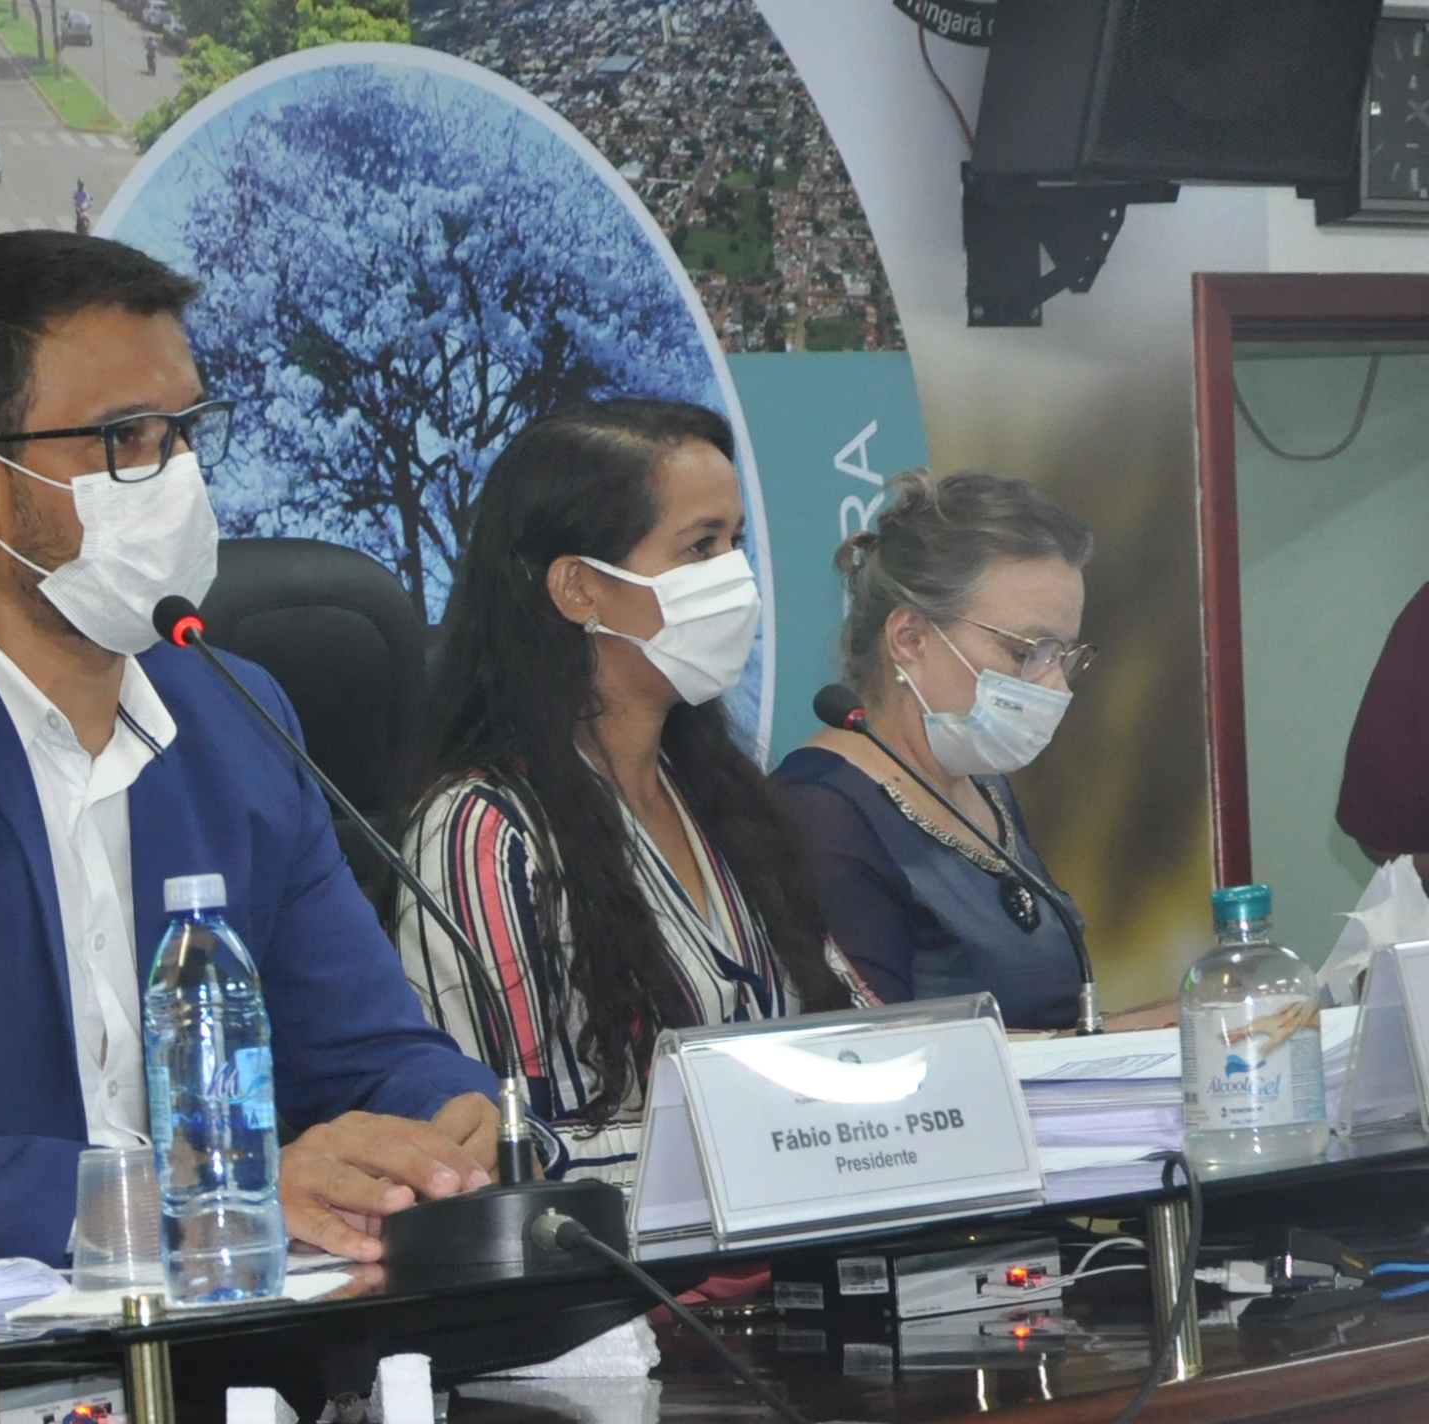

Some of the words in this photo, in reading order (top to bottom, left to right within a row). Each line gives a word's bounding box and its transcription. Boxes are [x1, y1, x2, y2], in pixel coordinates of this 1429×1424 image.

[771, 1127, 832, 1152] Fábio
[836, 1121, 889, 1144] Brito
[905, 1107, 965, 1135] PSDB
[835, 1149, 918, 1174] Presidente
